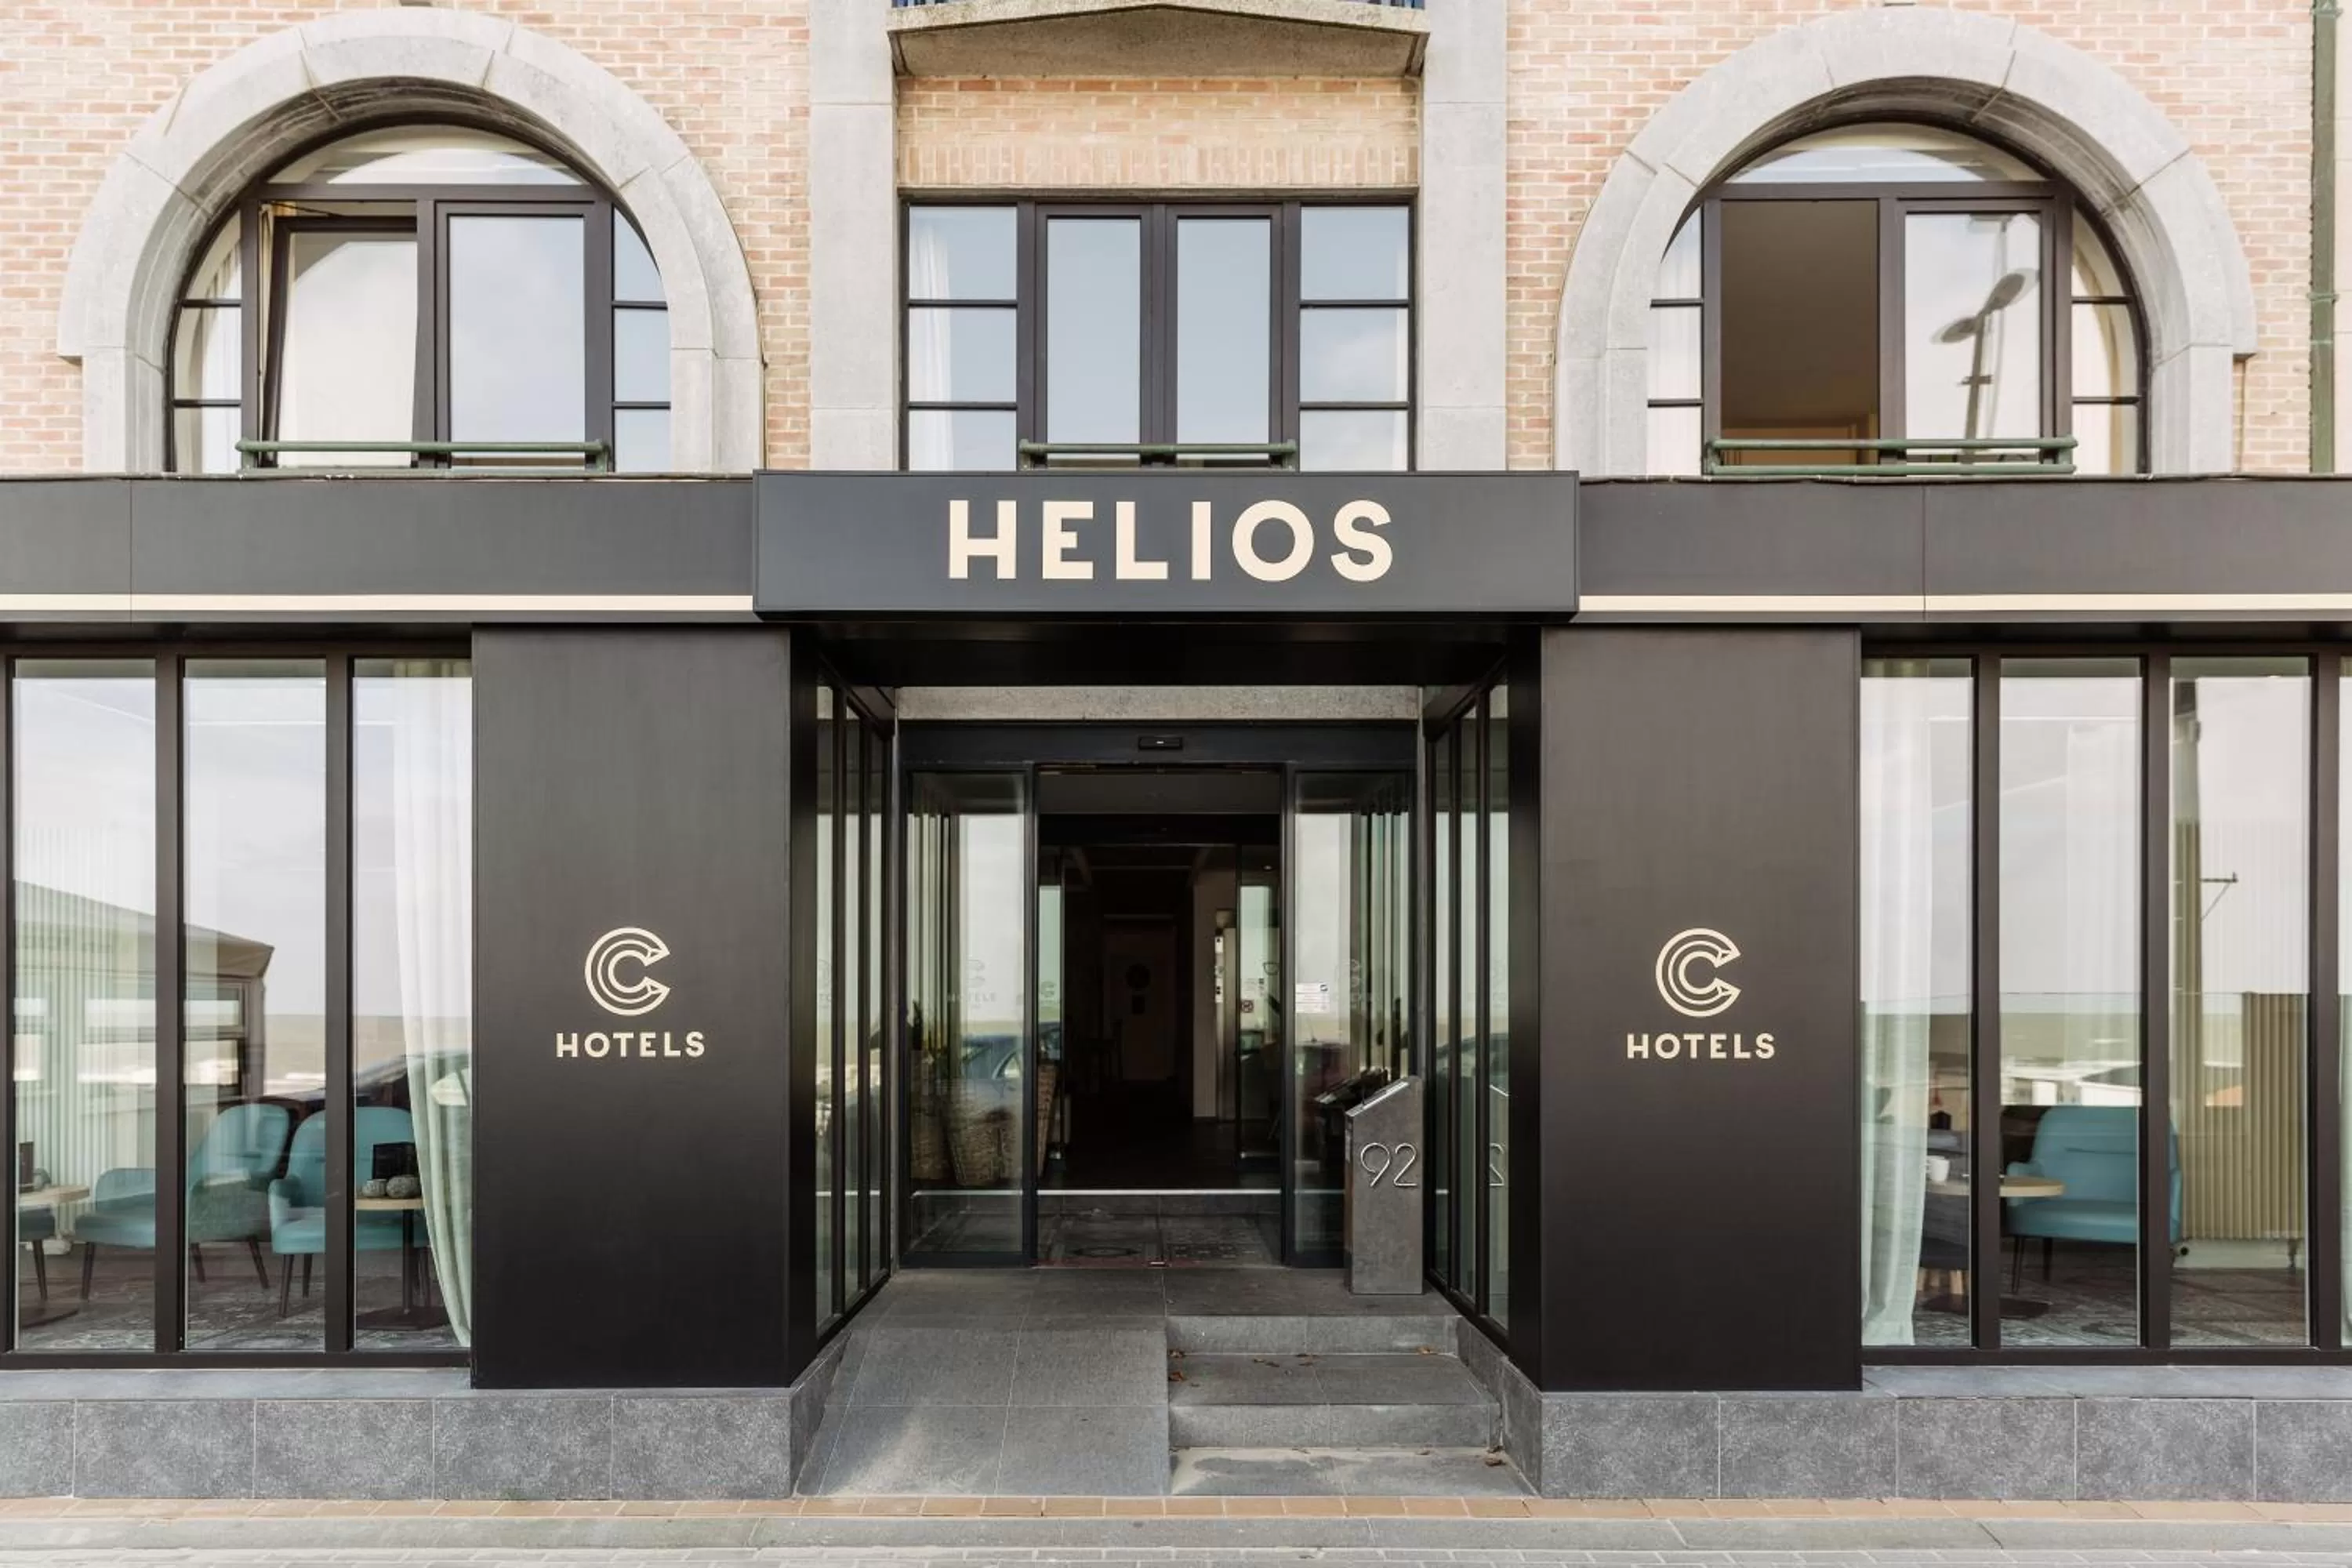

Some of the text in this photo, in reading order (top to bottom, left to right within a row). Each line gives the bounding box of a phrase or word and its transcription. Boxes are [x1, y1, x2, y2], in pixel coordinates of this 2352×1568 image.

[947, 499, 1393, 583] HELIOS
[585, 927, 670, 1016] C
[1655, 927, 1741, 1018] C
[556, 1031, 705, 1058] HOTELS
[1627, 1033, 1775, 1059] HOTELS
[1360, 1142, 1417, 1187] 92
